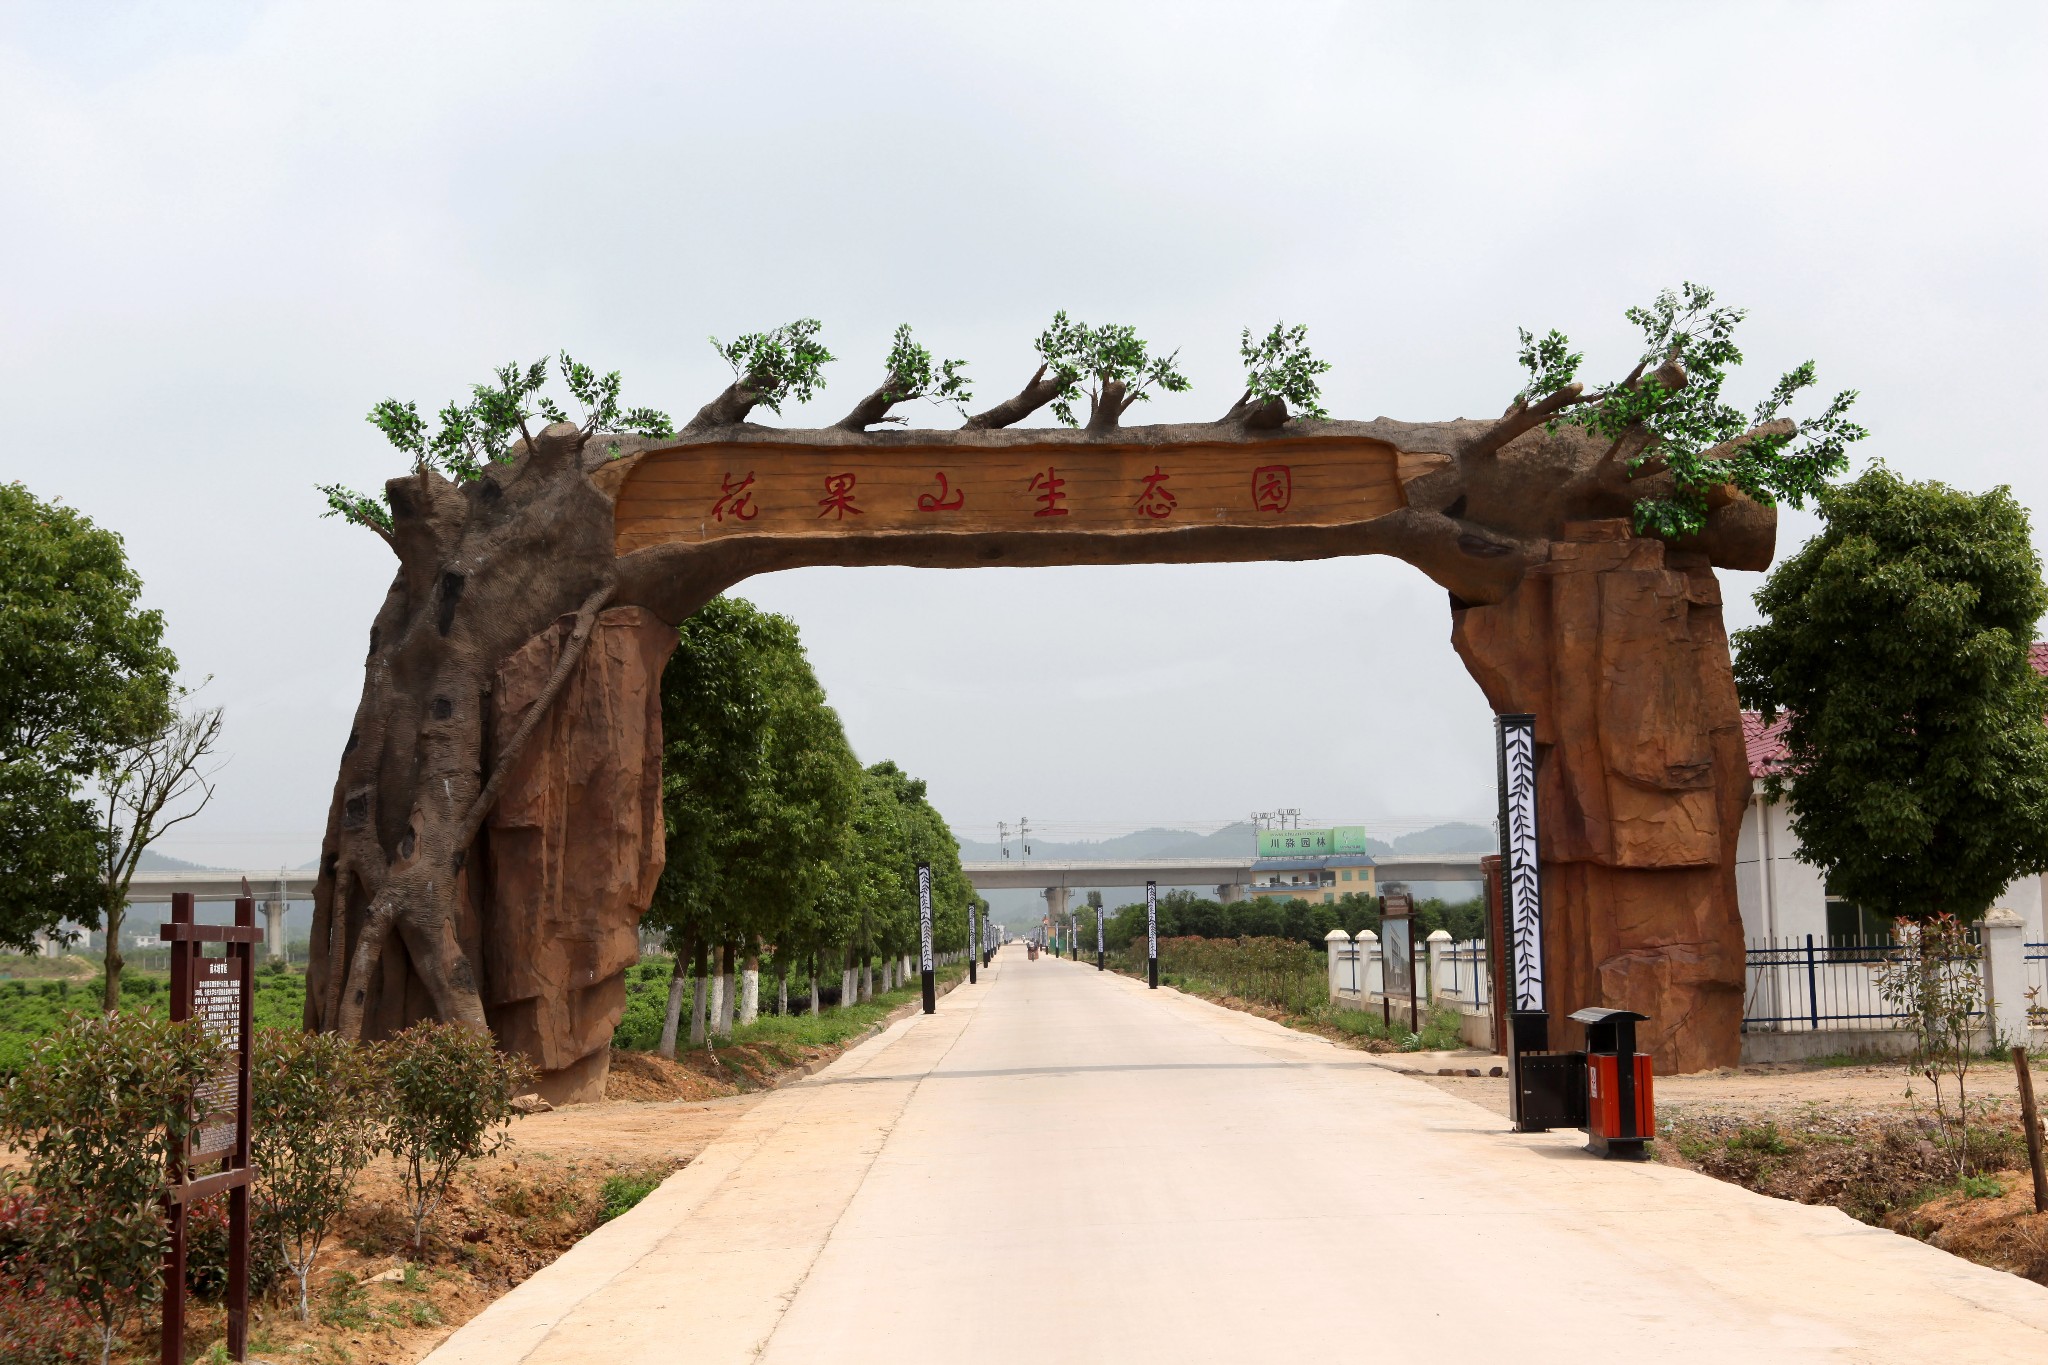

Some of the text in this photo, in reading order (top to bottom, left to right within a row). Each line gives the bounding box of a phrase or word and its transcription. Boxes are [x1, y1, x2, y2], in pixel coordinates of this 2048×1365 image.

[712, 465, 1293, 522] 花果山生态园
